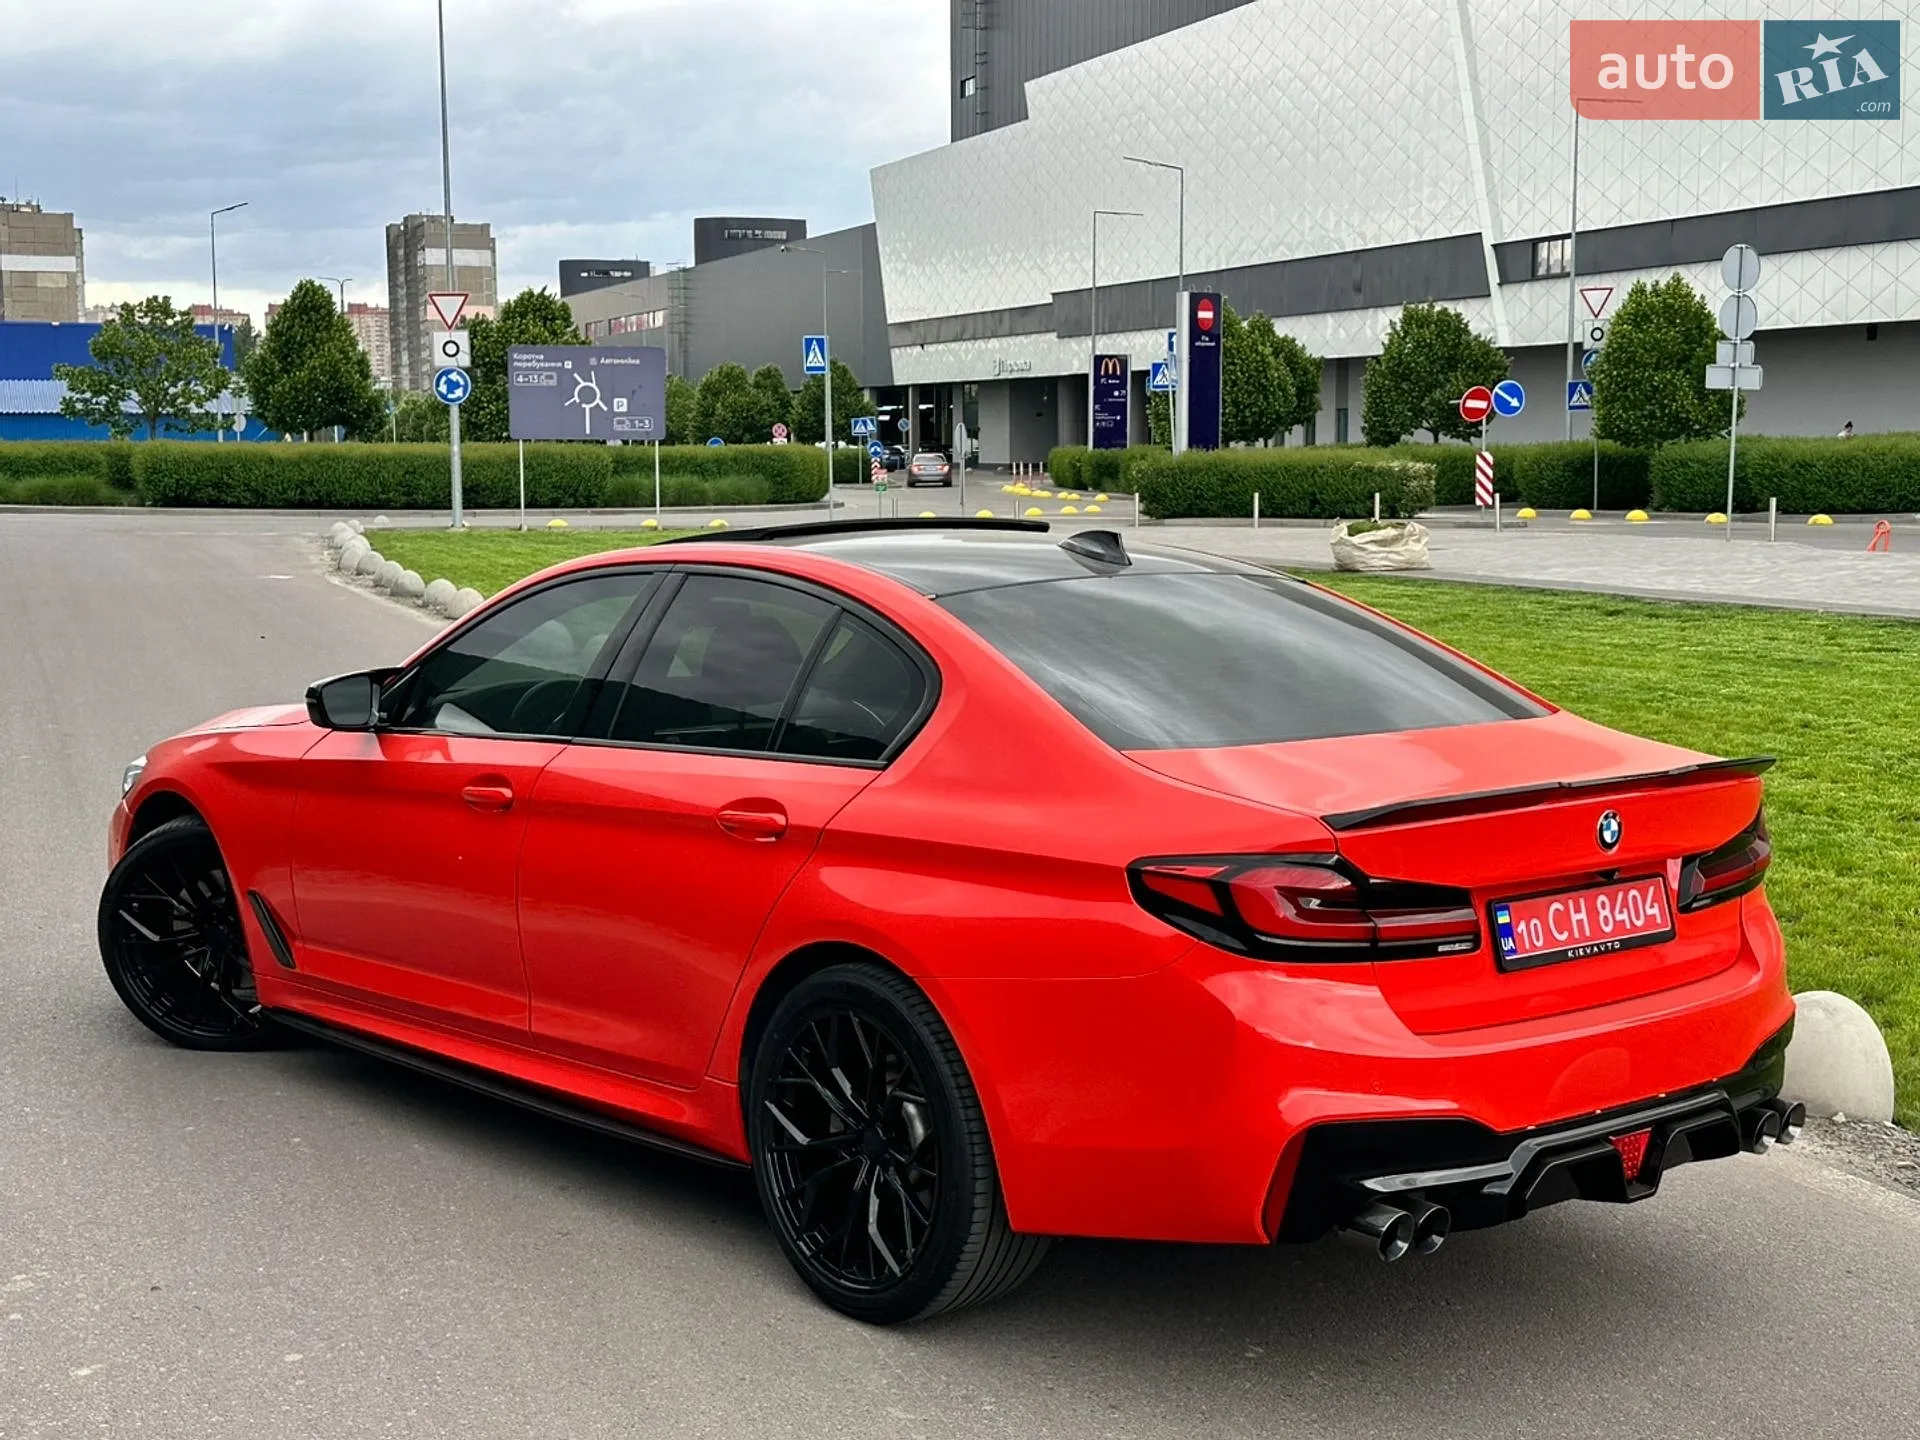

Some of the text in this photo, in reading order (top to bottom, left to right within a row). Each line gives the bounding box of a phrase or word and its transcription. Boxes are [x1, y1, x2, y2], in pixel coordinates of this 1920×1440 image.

[1517, 885, 1662, 950] 10 CH 8404
[1501, 937, 1515, 951] UA
[1567, 941, 1621, 958] KIEVAVTO
